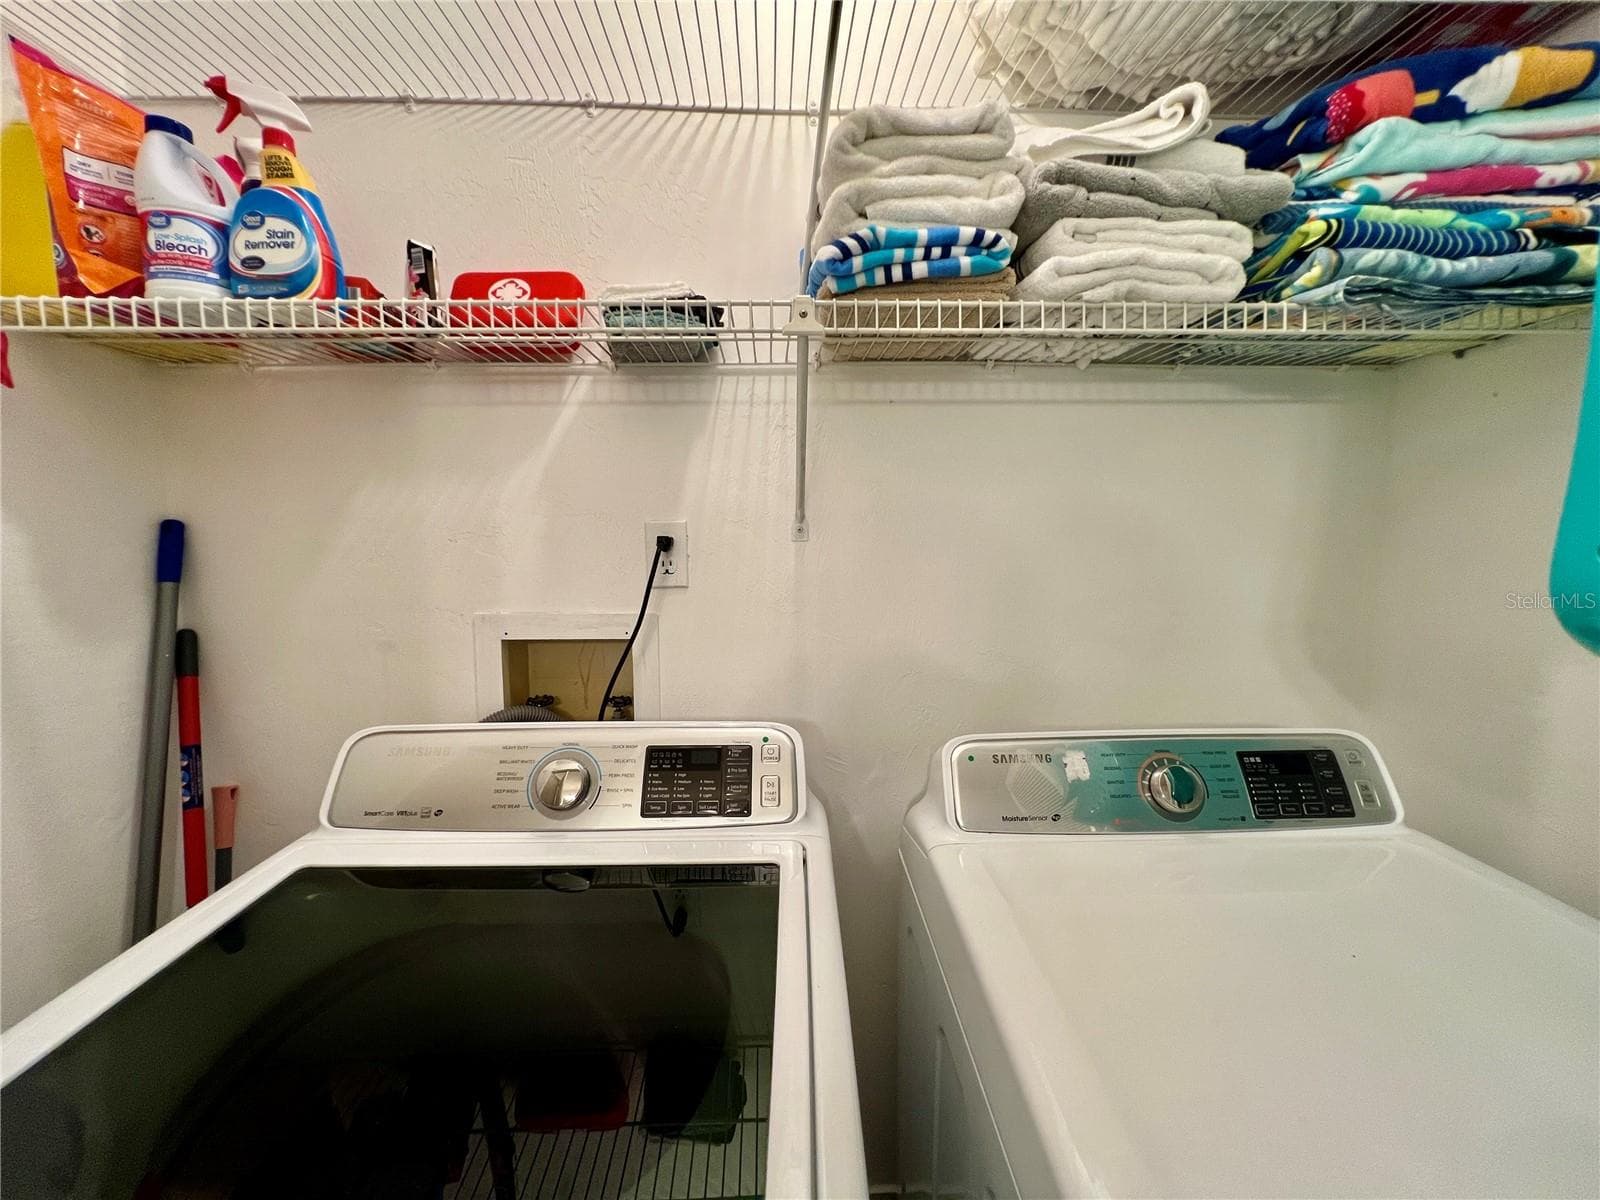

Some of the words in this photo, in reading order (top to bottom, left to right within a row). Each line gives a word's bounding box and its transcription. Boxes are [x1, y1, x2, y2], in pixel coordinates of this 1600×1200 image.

[154, 232, 208, 245] Low-Splash
[266, 229, 295, 239] Stain
[155, 240, 208, 256] Bleach
[244, 240, 295, 250] Remover
[992, 753, 1052, 764] SAMNG
[1001, 814, 1048, 822] MoistureSensor
